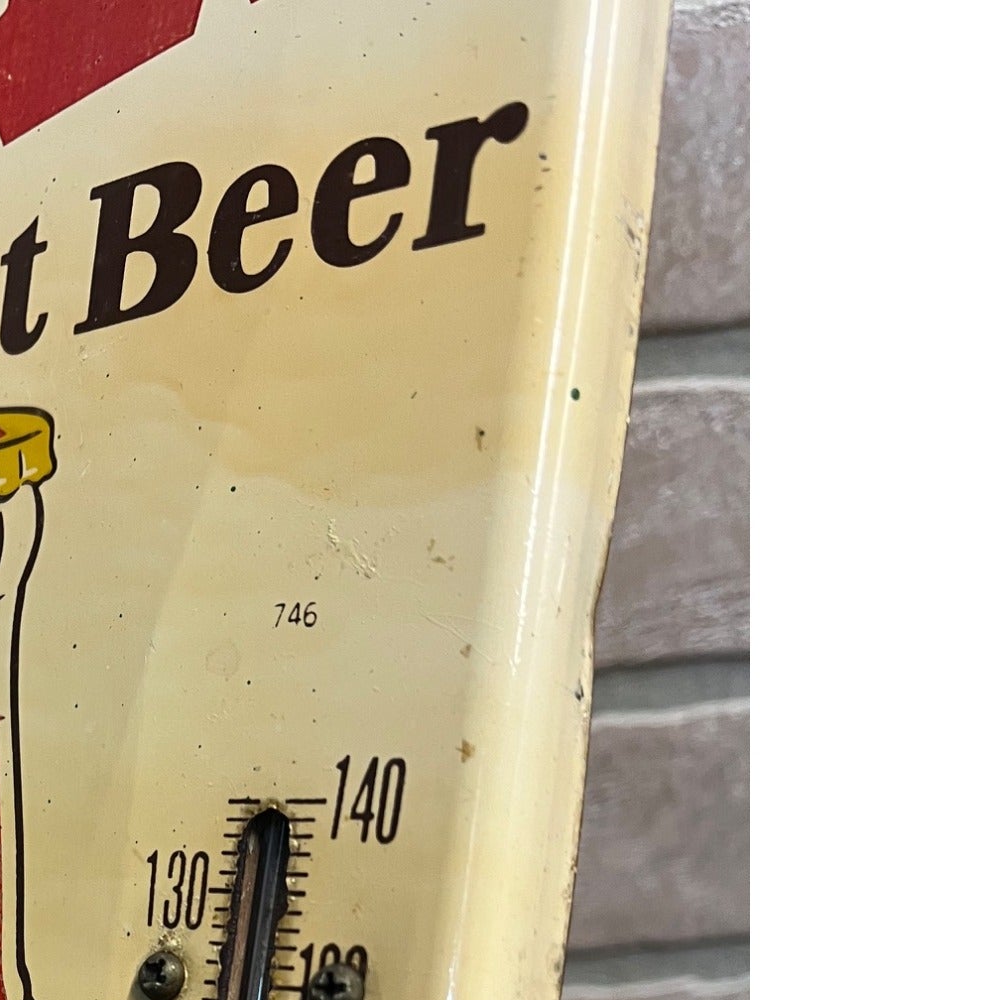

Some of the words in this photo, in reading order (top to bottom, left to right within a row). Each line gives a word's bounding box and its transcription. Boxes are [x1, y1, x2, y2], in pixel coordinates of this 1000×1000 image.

[74, 101, 530, 335] Beer
[274, 602, 317, 628] 746
[331, 755, 406, 844] 140
[147, 850, 209, 930] 130
